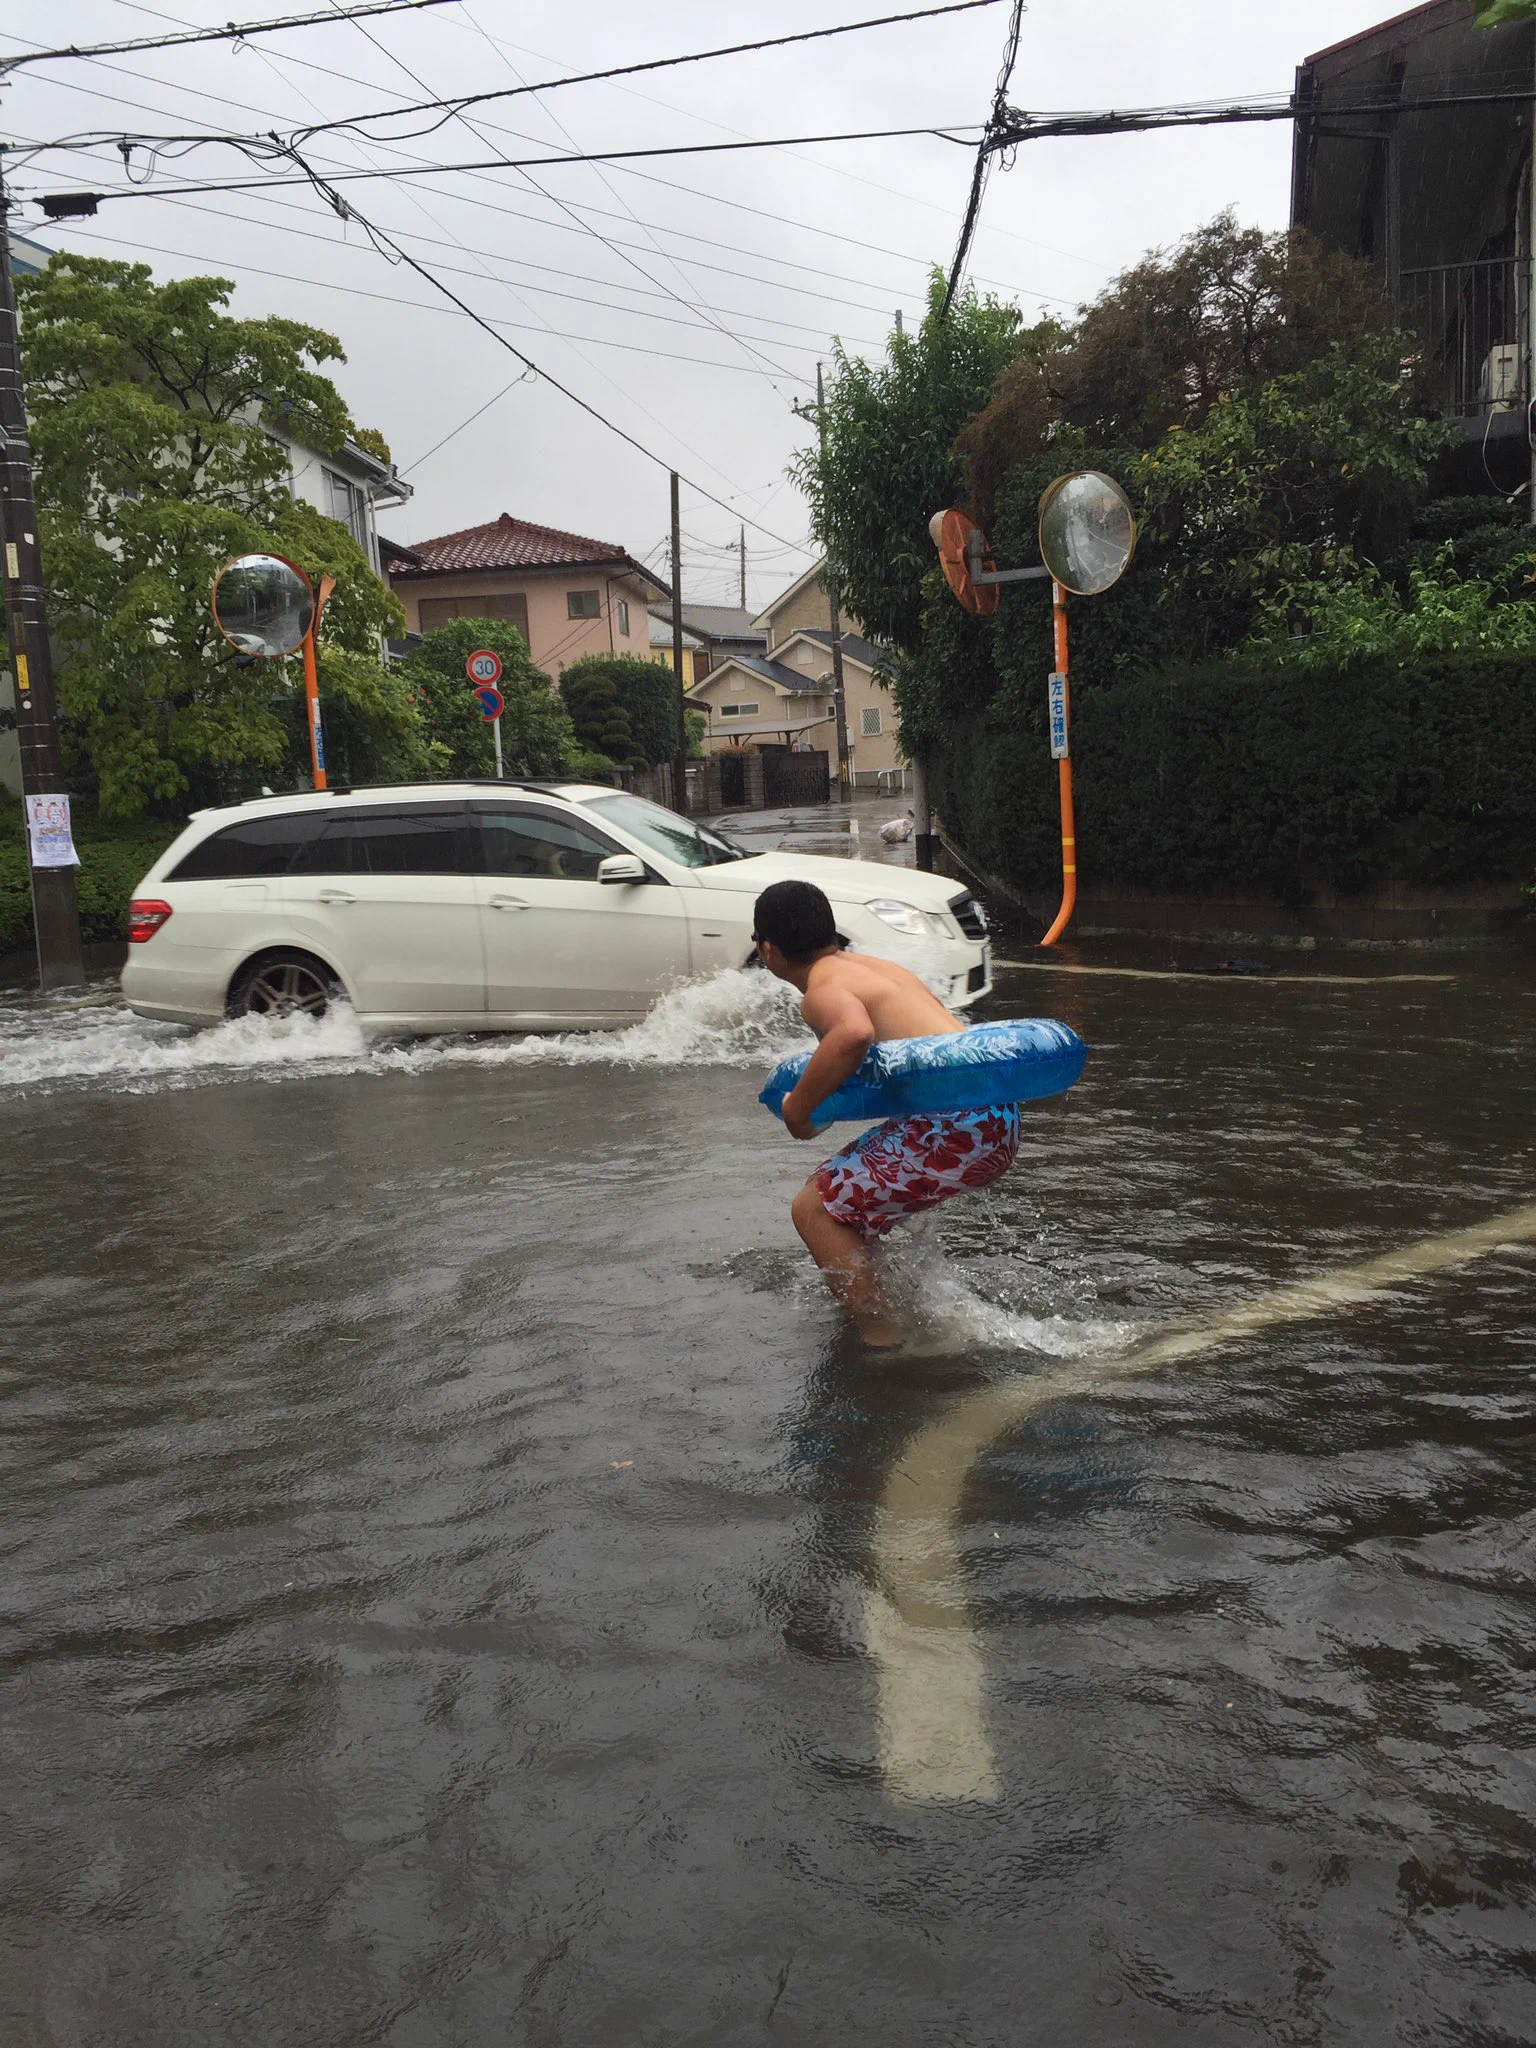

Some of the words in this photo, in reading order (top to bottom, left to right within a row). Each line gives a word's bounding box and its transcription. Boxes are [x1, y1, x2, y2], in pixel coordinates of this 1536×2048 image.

[475, 660, 494, 675] 30
[1051, 680, 1065, 748] 左右確認
